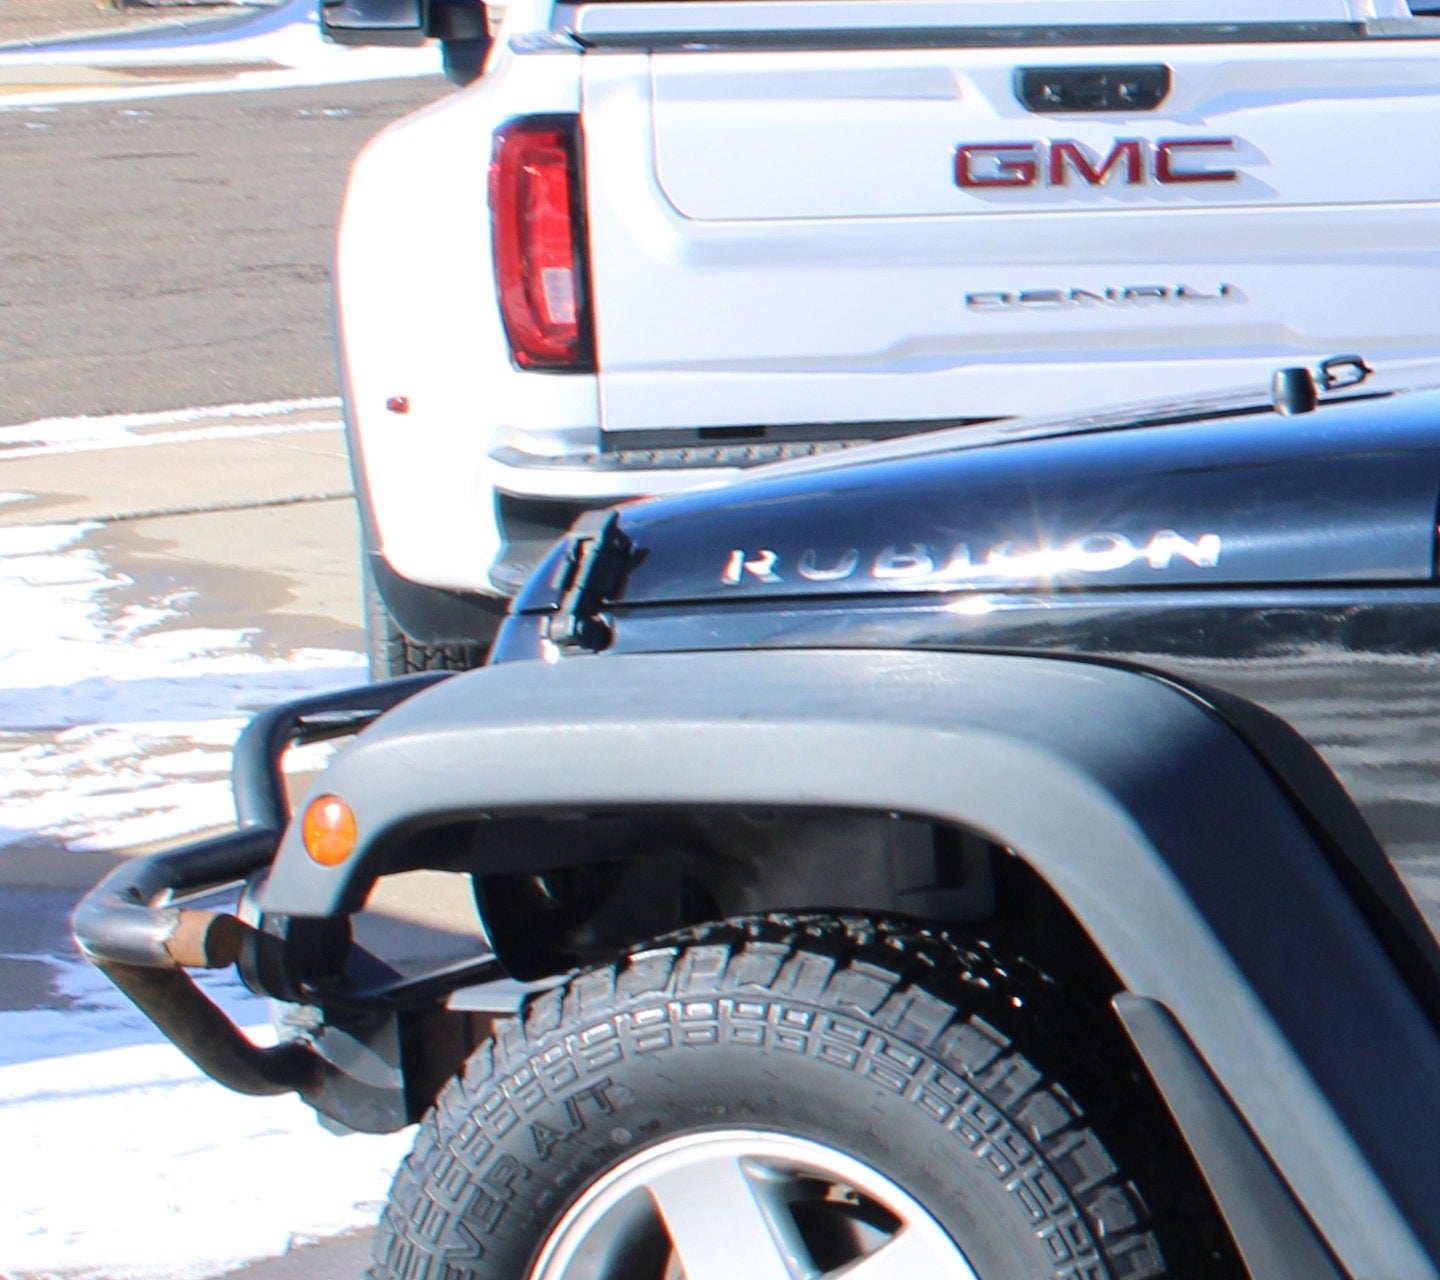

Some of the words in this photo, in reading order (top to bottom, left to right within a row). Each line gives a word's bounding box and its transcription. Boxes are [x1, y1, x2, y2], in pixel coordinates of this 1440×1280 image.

[955, 137, 1238, 189] GMC
[964, 282, 1234, 308] DENALI
[720, 528, 1222, 585] RUBICON
